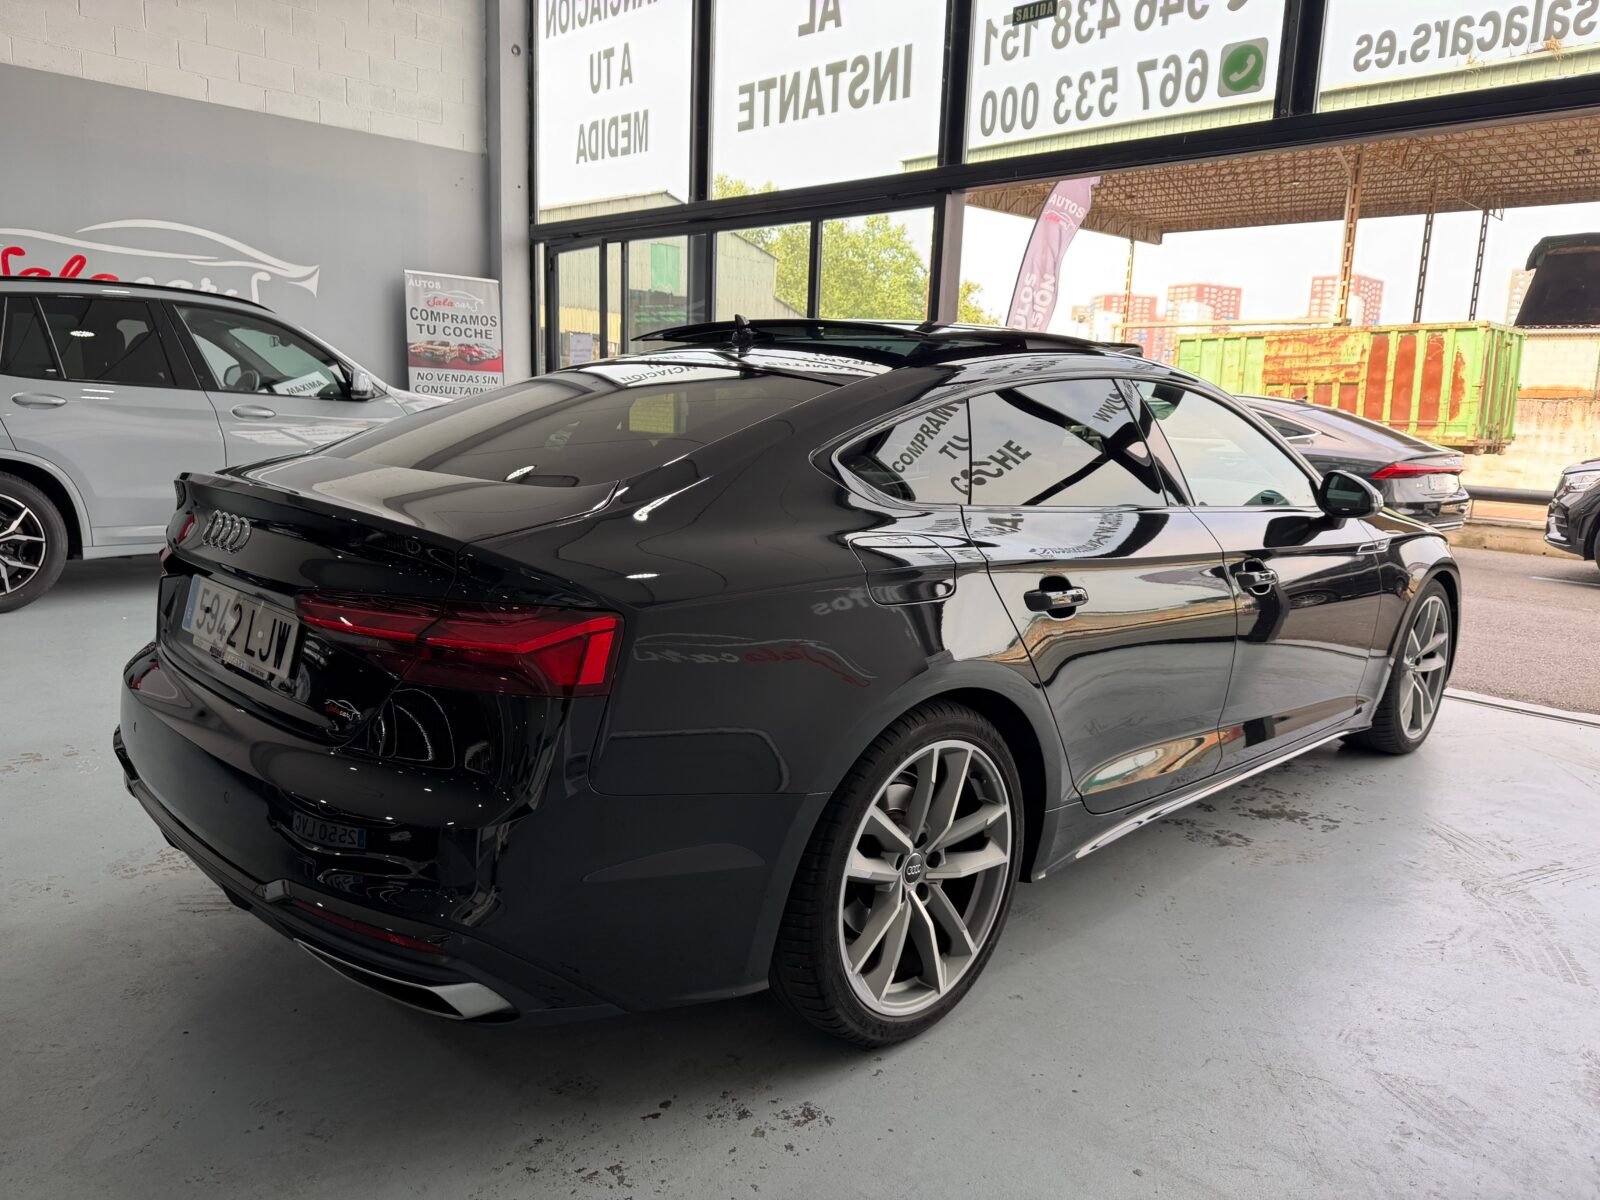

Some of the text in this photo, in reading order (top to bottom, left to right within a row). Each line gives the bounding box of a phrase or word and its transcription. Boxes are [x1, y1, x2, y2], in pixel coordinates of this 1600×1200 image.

[1015, 1, 1054, 22] SALIDA
[1048, 194, 1086, 218] AUTOS
[408, 278, 441, 289] AUTOS
[410, 306, 498, 327] COMPRAMOS
[416, 323, 493, 340] TU COCHE
[286, 379, 325, 395] MAXIMA
[416, 372, 499, 385] NO VENDAS SIN
[195, 587, 243, 648] 5942
[243, 608, 292, 670] LJW
